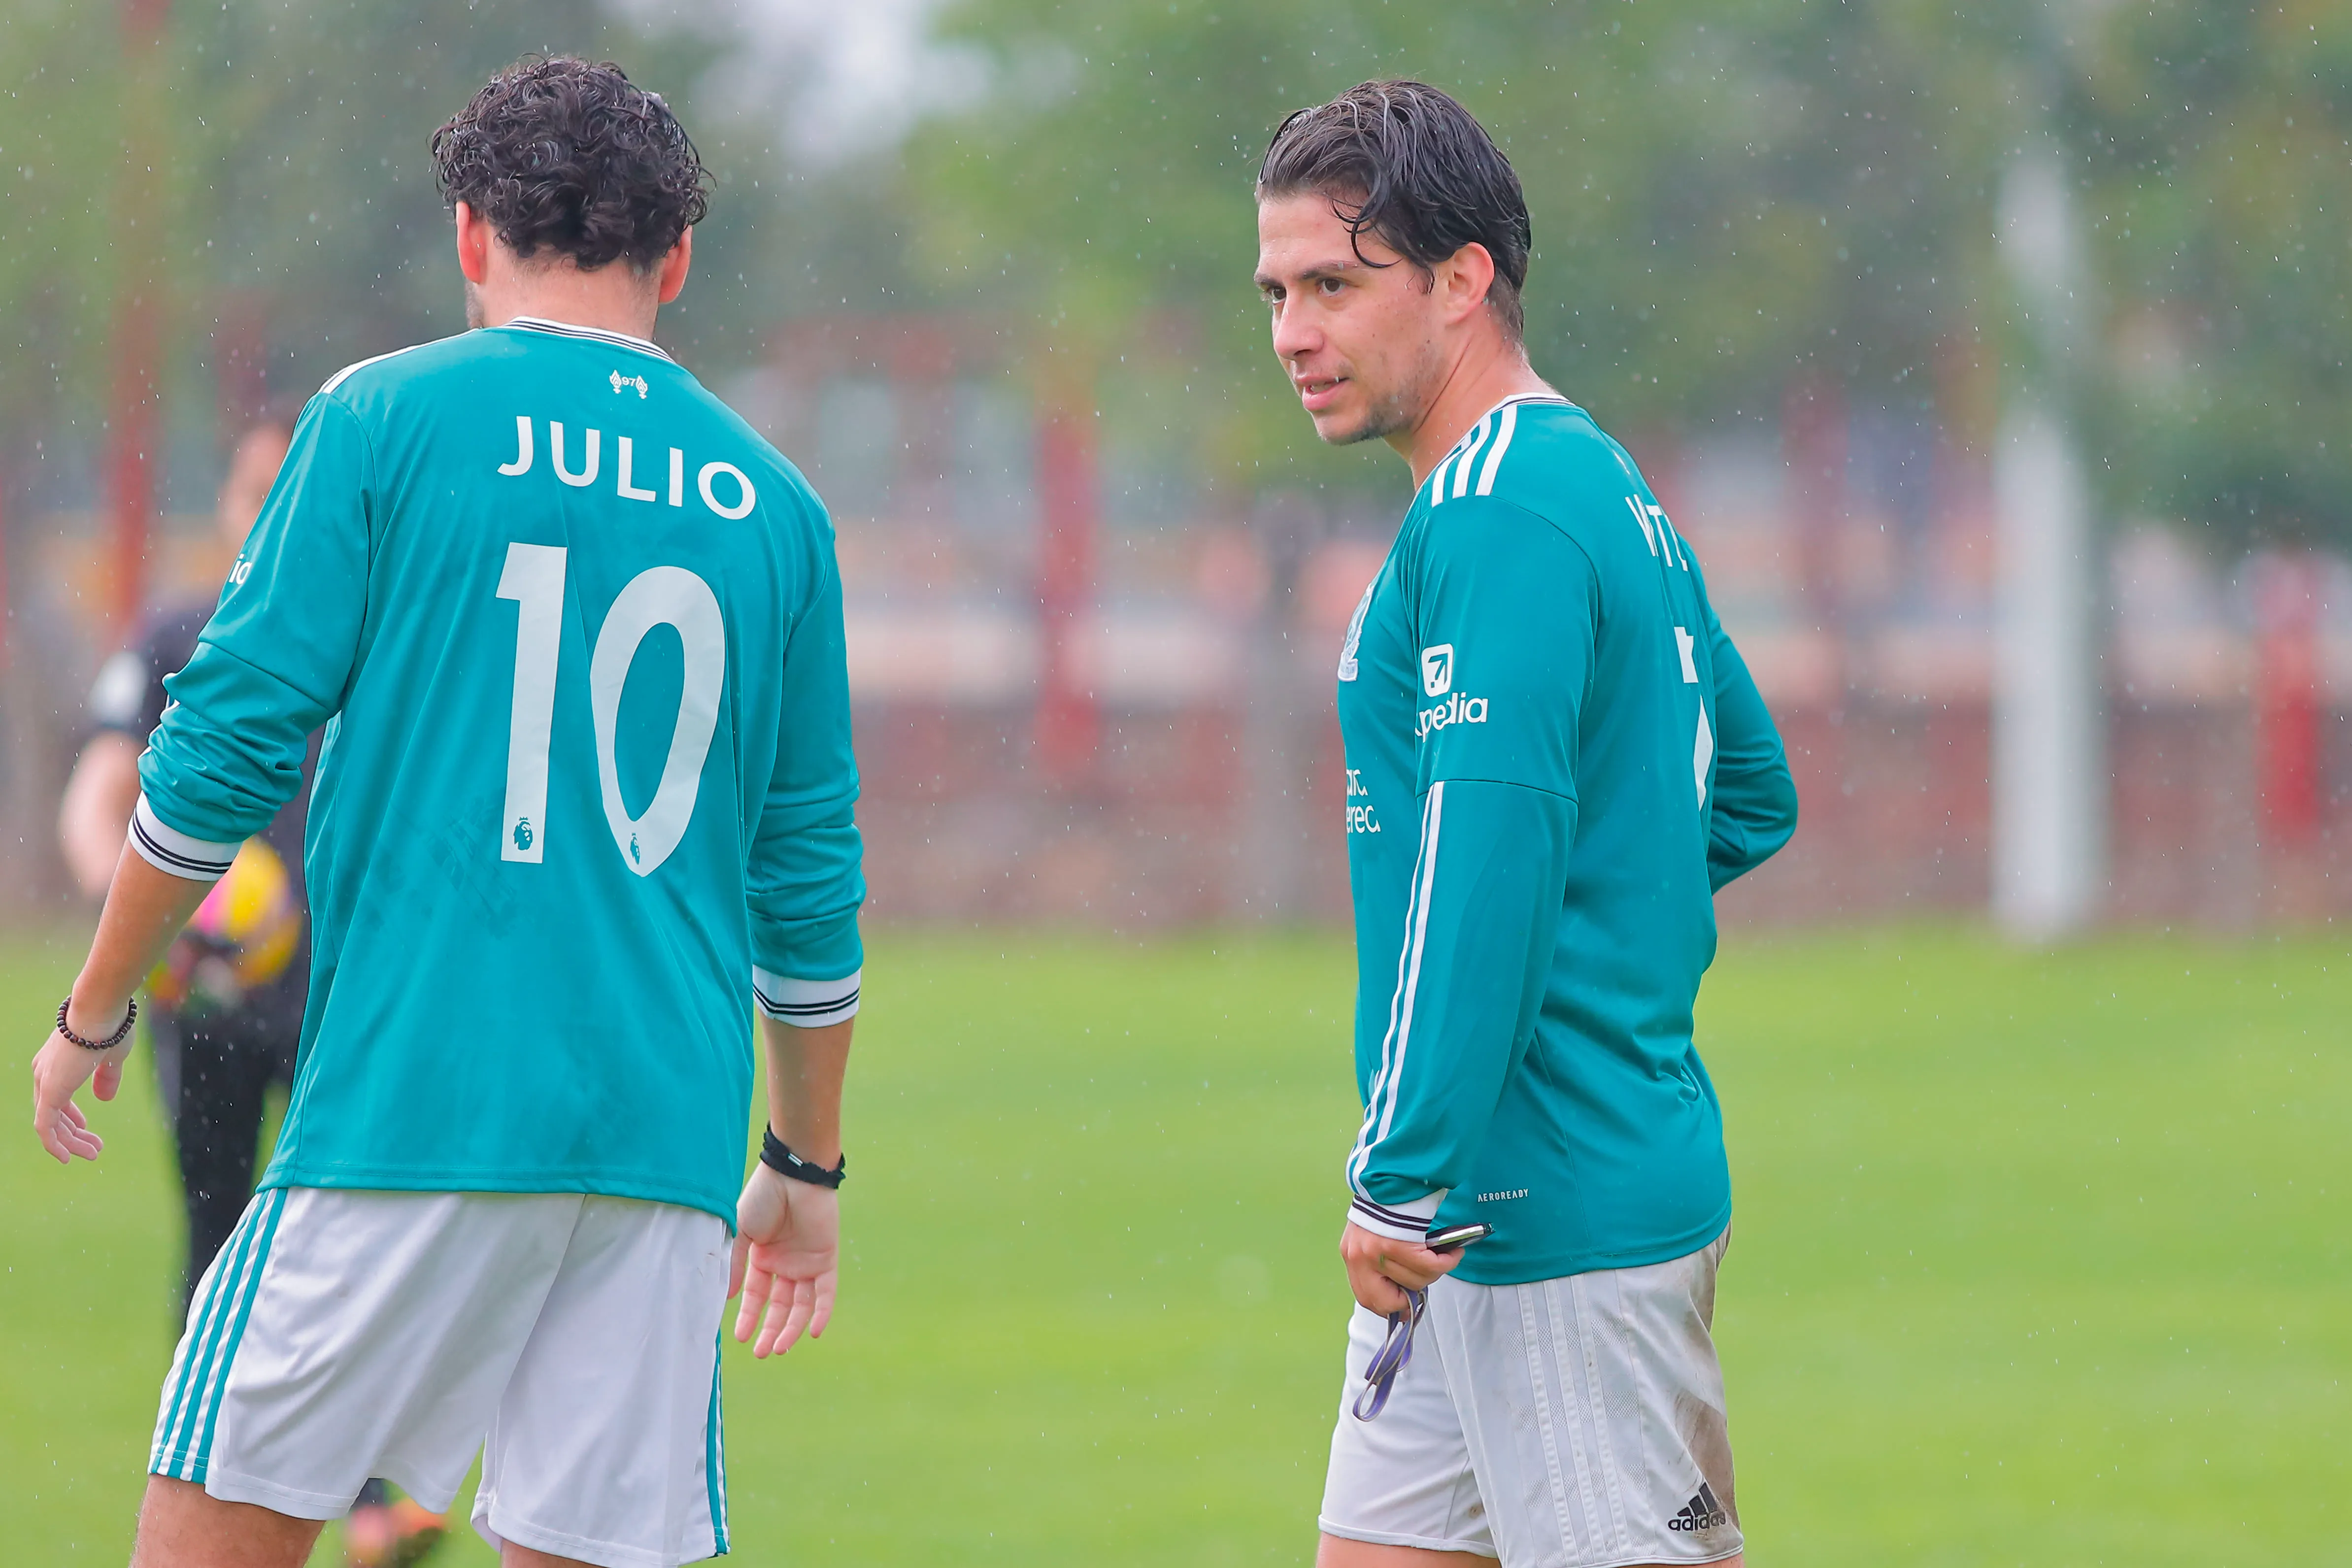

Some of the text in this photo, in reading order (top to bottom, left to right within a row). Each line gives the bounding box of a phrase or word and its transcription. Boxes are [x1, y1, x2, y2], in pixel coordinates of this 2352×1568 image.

[497, 416, 756, 520] JULIO
[496, 542, 725, 877] 10
[1415, 692, 1488, 743] pedia
[1478, 1188, 1528, 1202] AEROREADY
